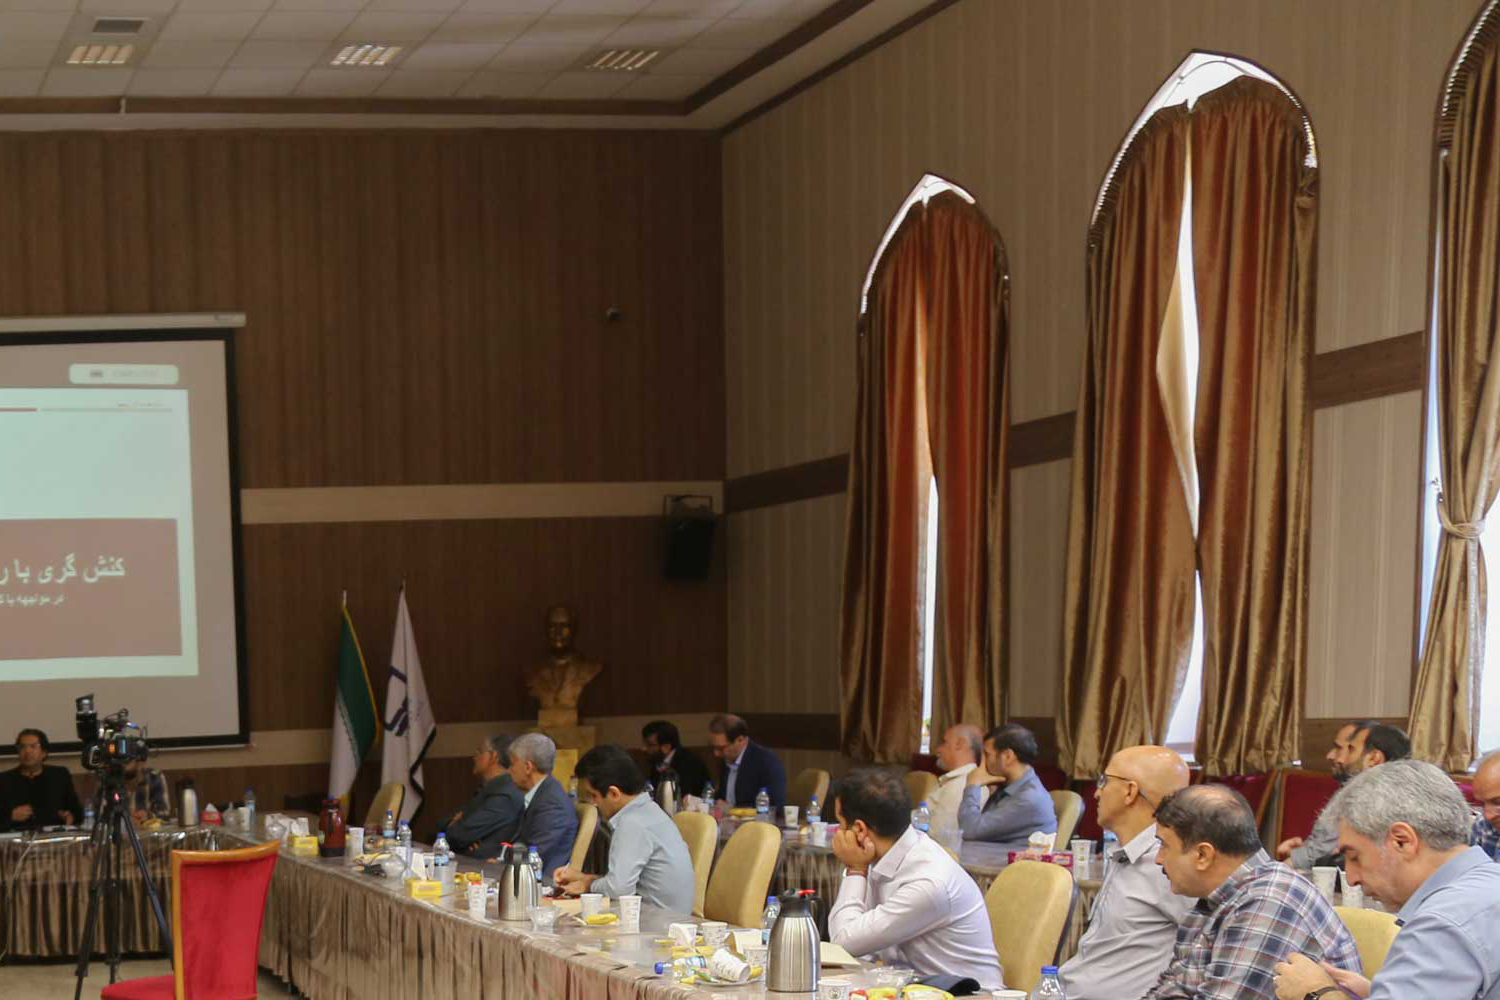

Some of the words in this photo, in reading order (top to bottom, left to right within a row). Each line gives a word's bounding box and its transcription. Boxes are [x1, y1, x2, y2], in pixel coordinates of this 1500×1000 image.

[14, 558, 31, 584] با
[37, 553, 77, 584] گری
[82, 555, 125, 583] کنش
